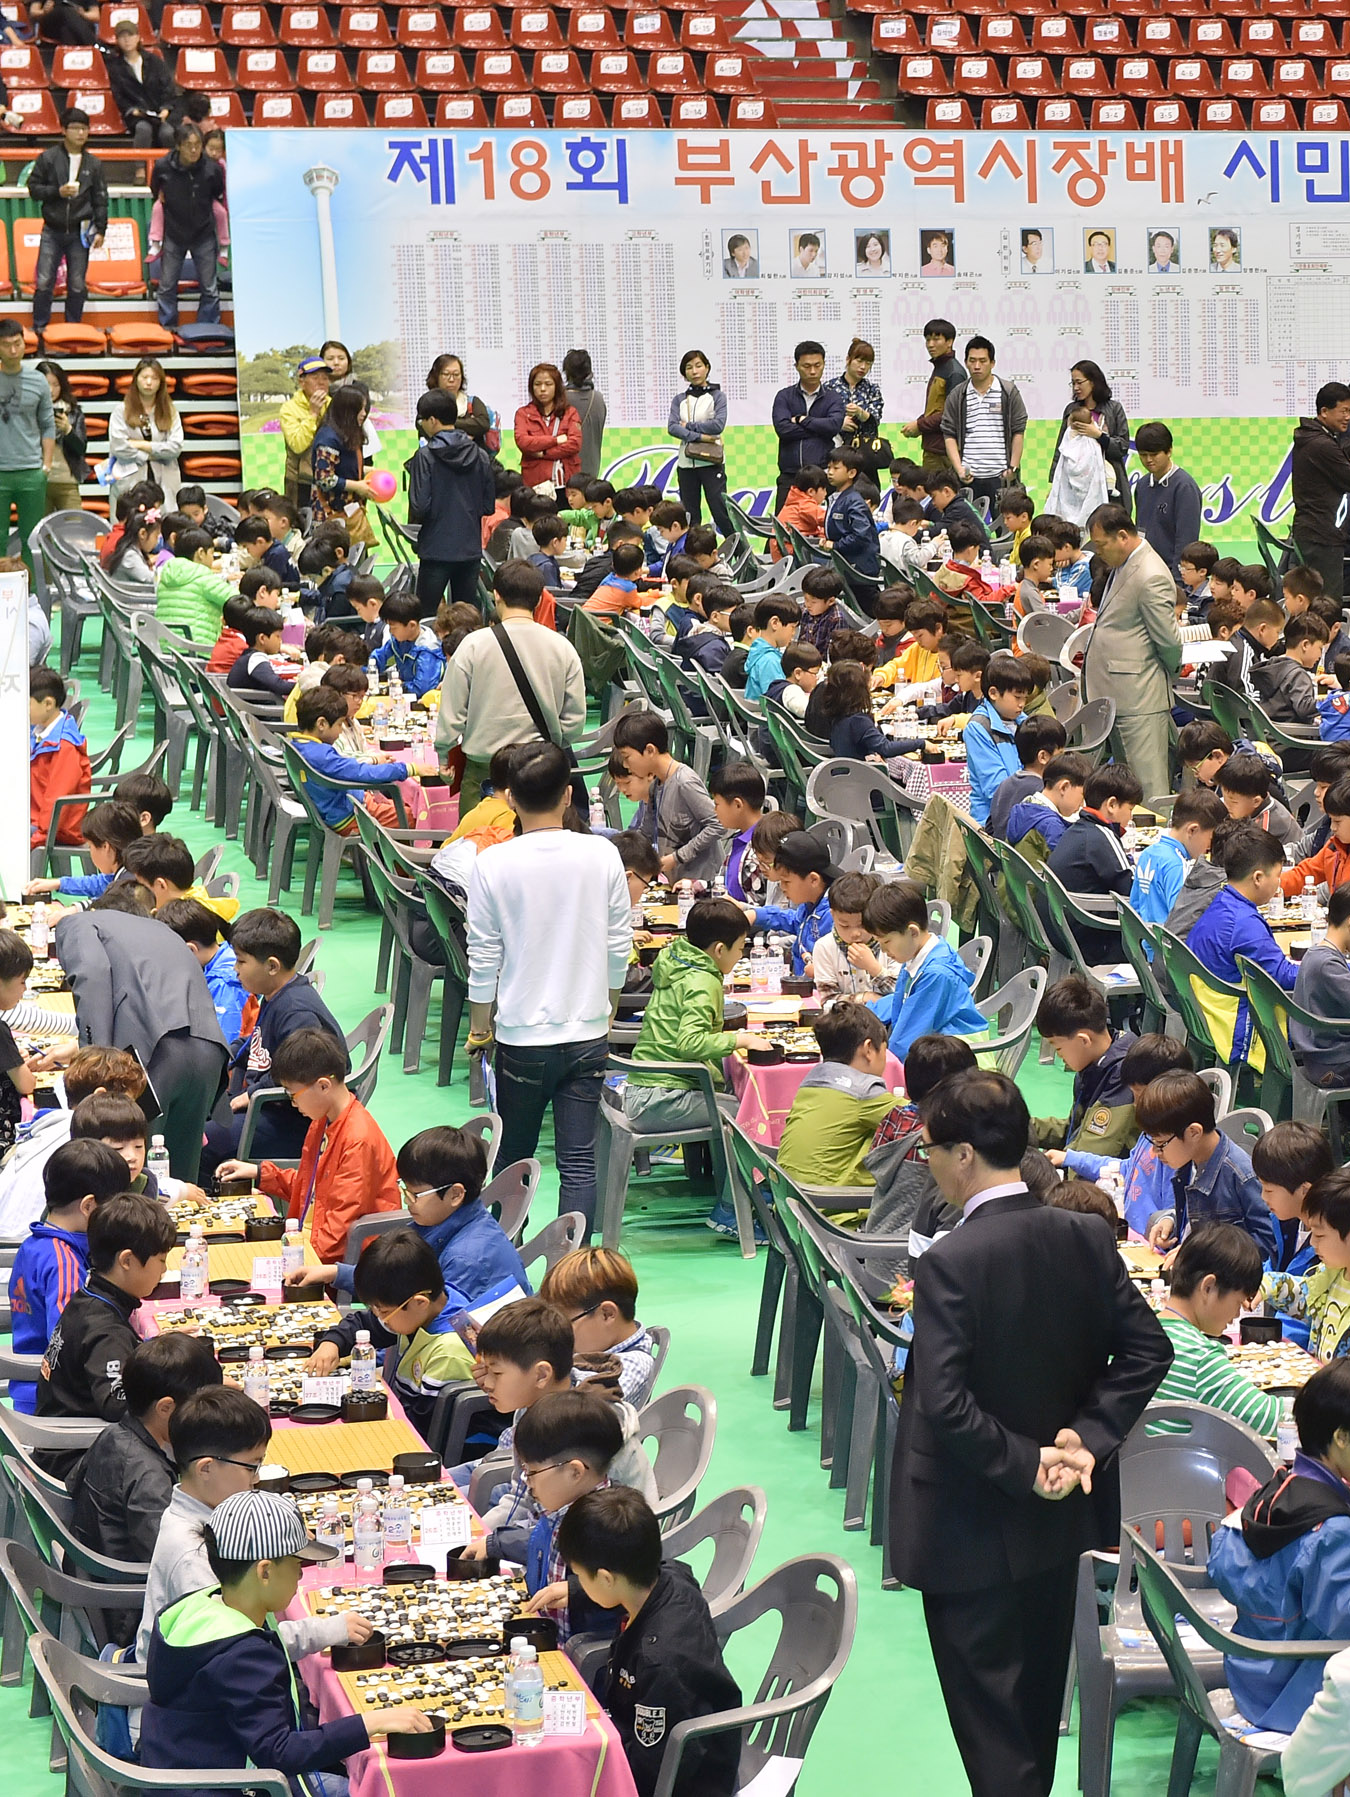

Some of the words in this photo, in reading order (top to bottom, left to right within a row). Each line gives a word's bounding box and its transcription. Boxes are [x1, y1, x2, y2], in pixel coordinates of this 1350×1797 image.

[1047, 26, 1060, 34] 5-4
[1152, 29, 1164, 37] 5-6
[1203, 30, 1215, 38] 5-7
[1255, 29, 1266, 37] 5-8
[968, 67, 980, 75] 4-2
[1022, 68, 1035, 76] 4-3
[1129, 68, 1141, 76] 4-5
[1337, 70, 1349, 78] 4-9
[942, 109, 953, 117] 3-1
[1051, 110, 1064, 118] 3-3
[1106, 111, 1118, 119] 3-4
[1159, 111, 1173, 119] 3-5
[1213, 110, 1225, 118] 3-6
[1266, 111, 1278, 119] 3-7
[1319, 111, 1331, 119] 3-8
[387, 136, 629, 205] 제18회
[675, 137, 1184, 207] 부산광역시장배
